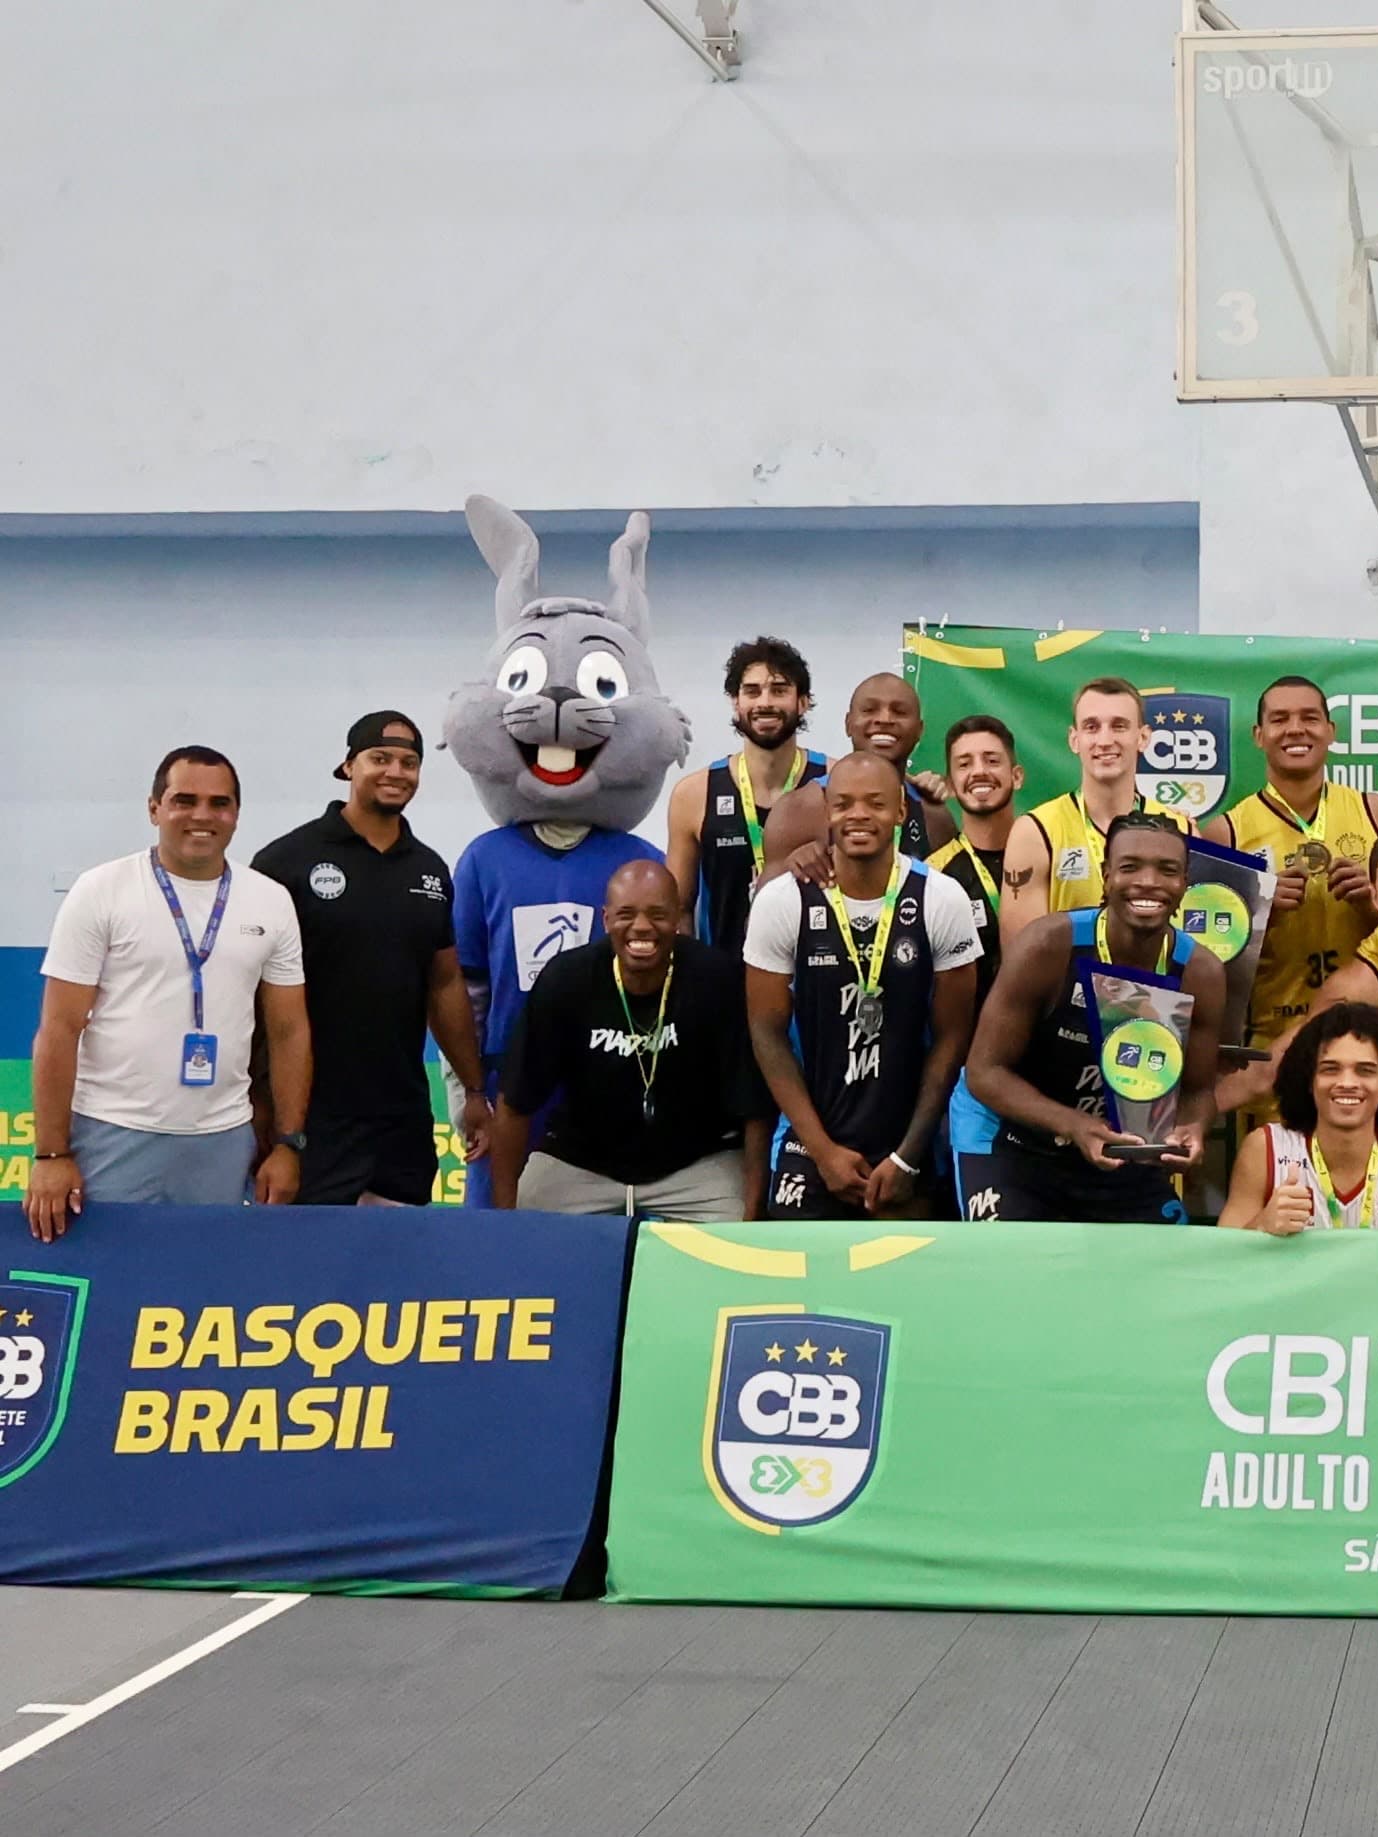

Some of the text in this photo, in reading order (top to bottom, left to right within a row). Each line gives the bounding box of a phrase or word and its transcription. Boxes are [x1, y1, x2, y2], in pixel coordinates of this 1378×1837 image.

[1215, 291, 1259, 346] 3
[1143, 729, 1218, 771] CBB
[314, 875, 342, 885] FPB
[130, 1298, 555, 1378] BASQUETE
[737, 1370, 862, 1440] CBB
[1206, 1334, 1370, 1437] CBI
[114, 1386, 393, 1454] BRASIL
[1200, 1451, 1370, 1512] ADULTO
